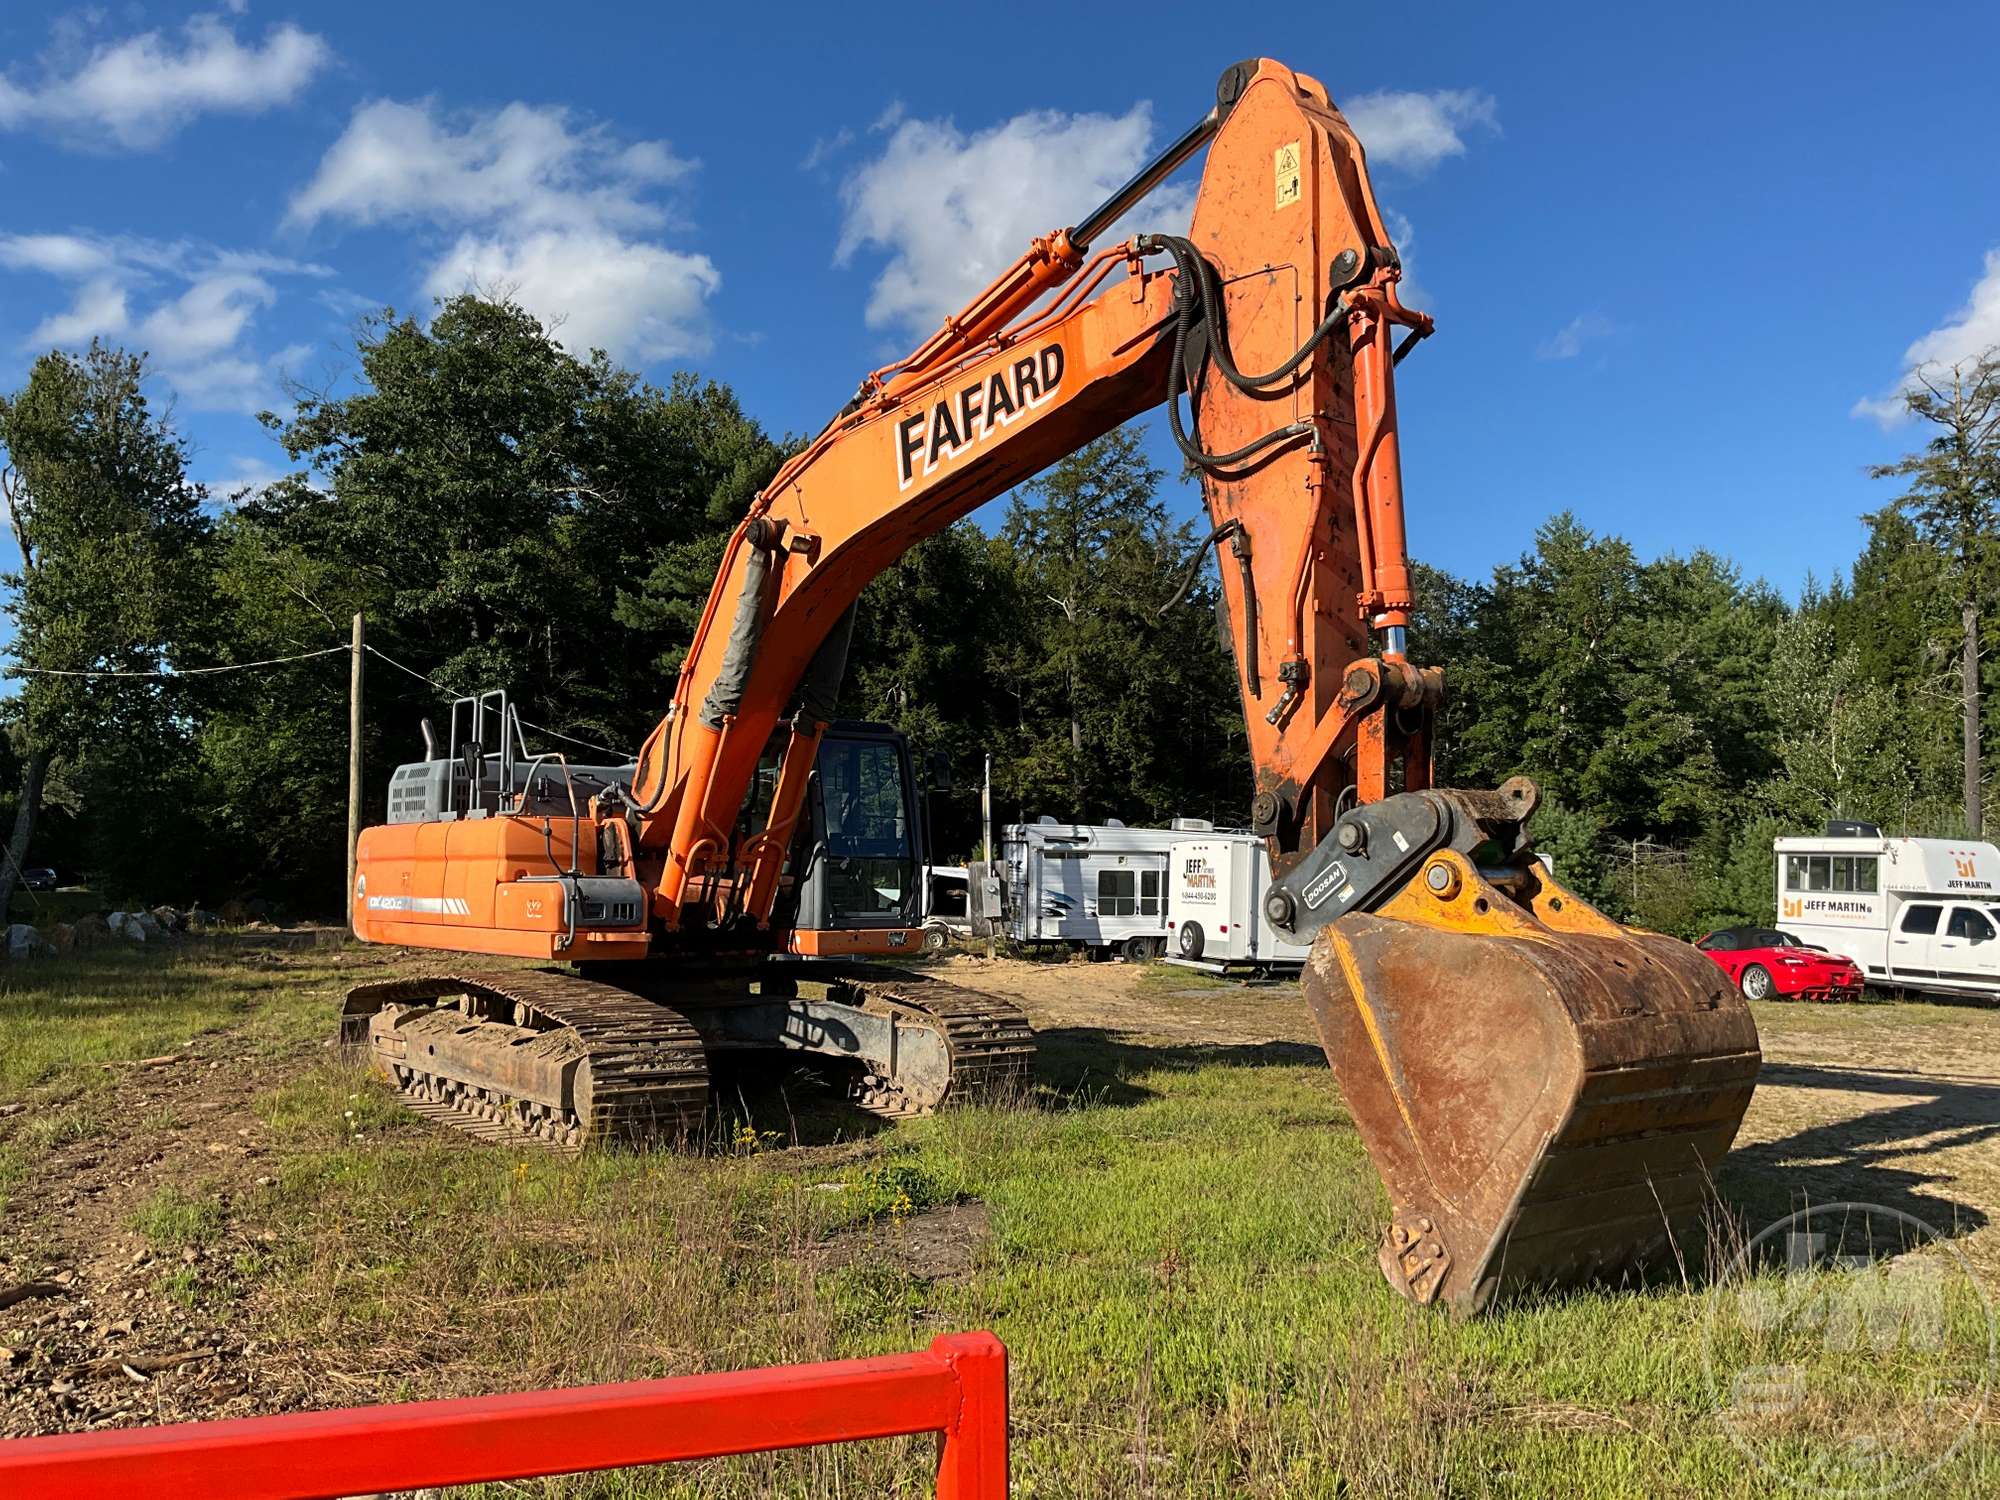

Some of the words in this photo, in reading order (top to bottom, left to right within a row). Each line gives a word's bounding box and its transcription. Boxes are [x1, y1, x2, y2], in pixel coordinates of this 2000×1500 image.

[896, 343, 1064, 490] FAFARD
[1183, 859, 1201, 878] JEFF
[1187, 874, 1214, 888] MARTIN
[1308, 868, 1340, 901] DOOSAN
[1947, 880, 1963, 888] JEFF
[1964, 881, 1992, 889] MARTIN
[1804, 900, 1826, 911] JEFF
[1828, 902, 1866, 912] MARTIN
